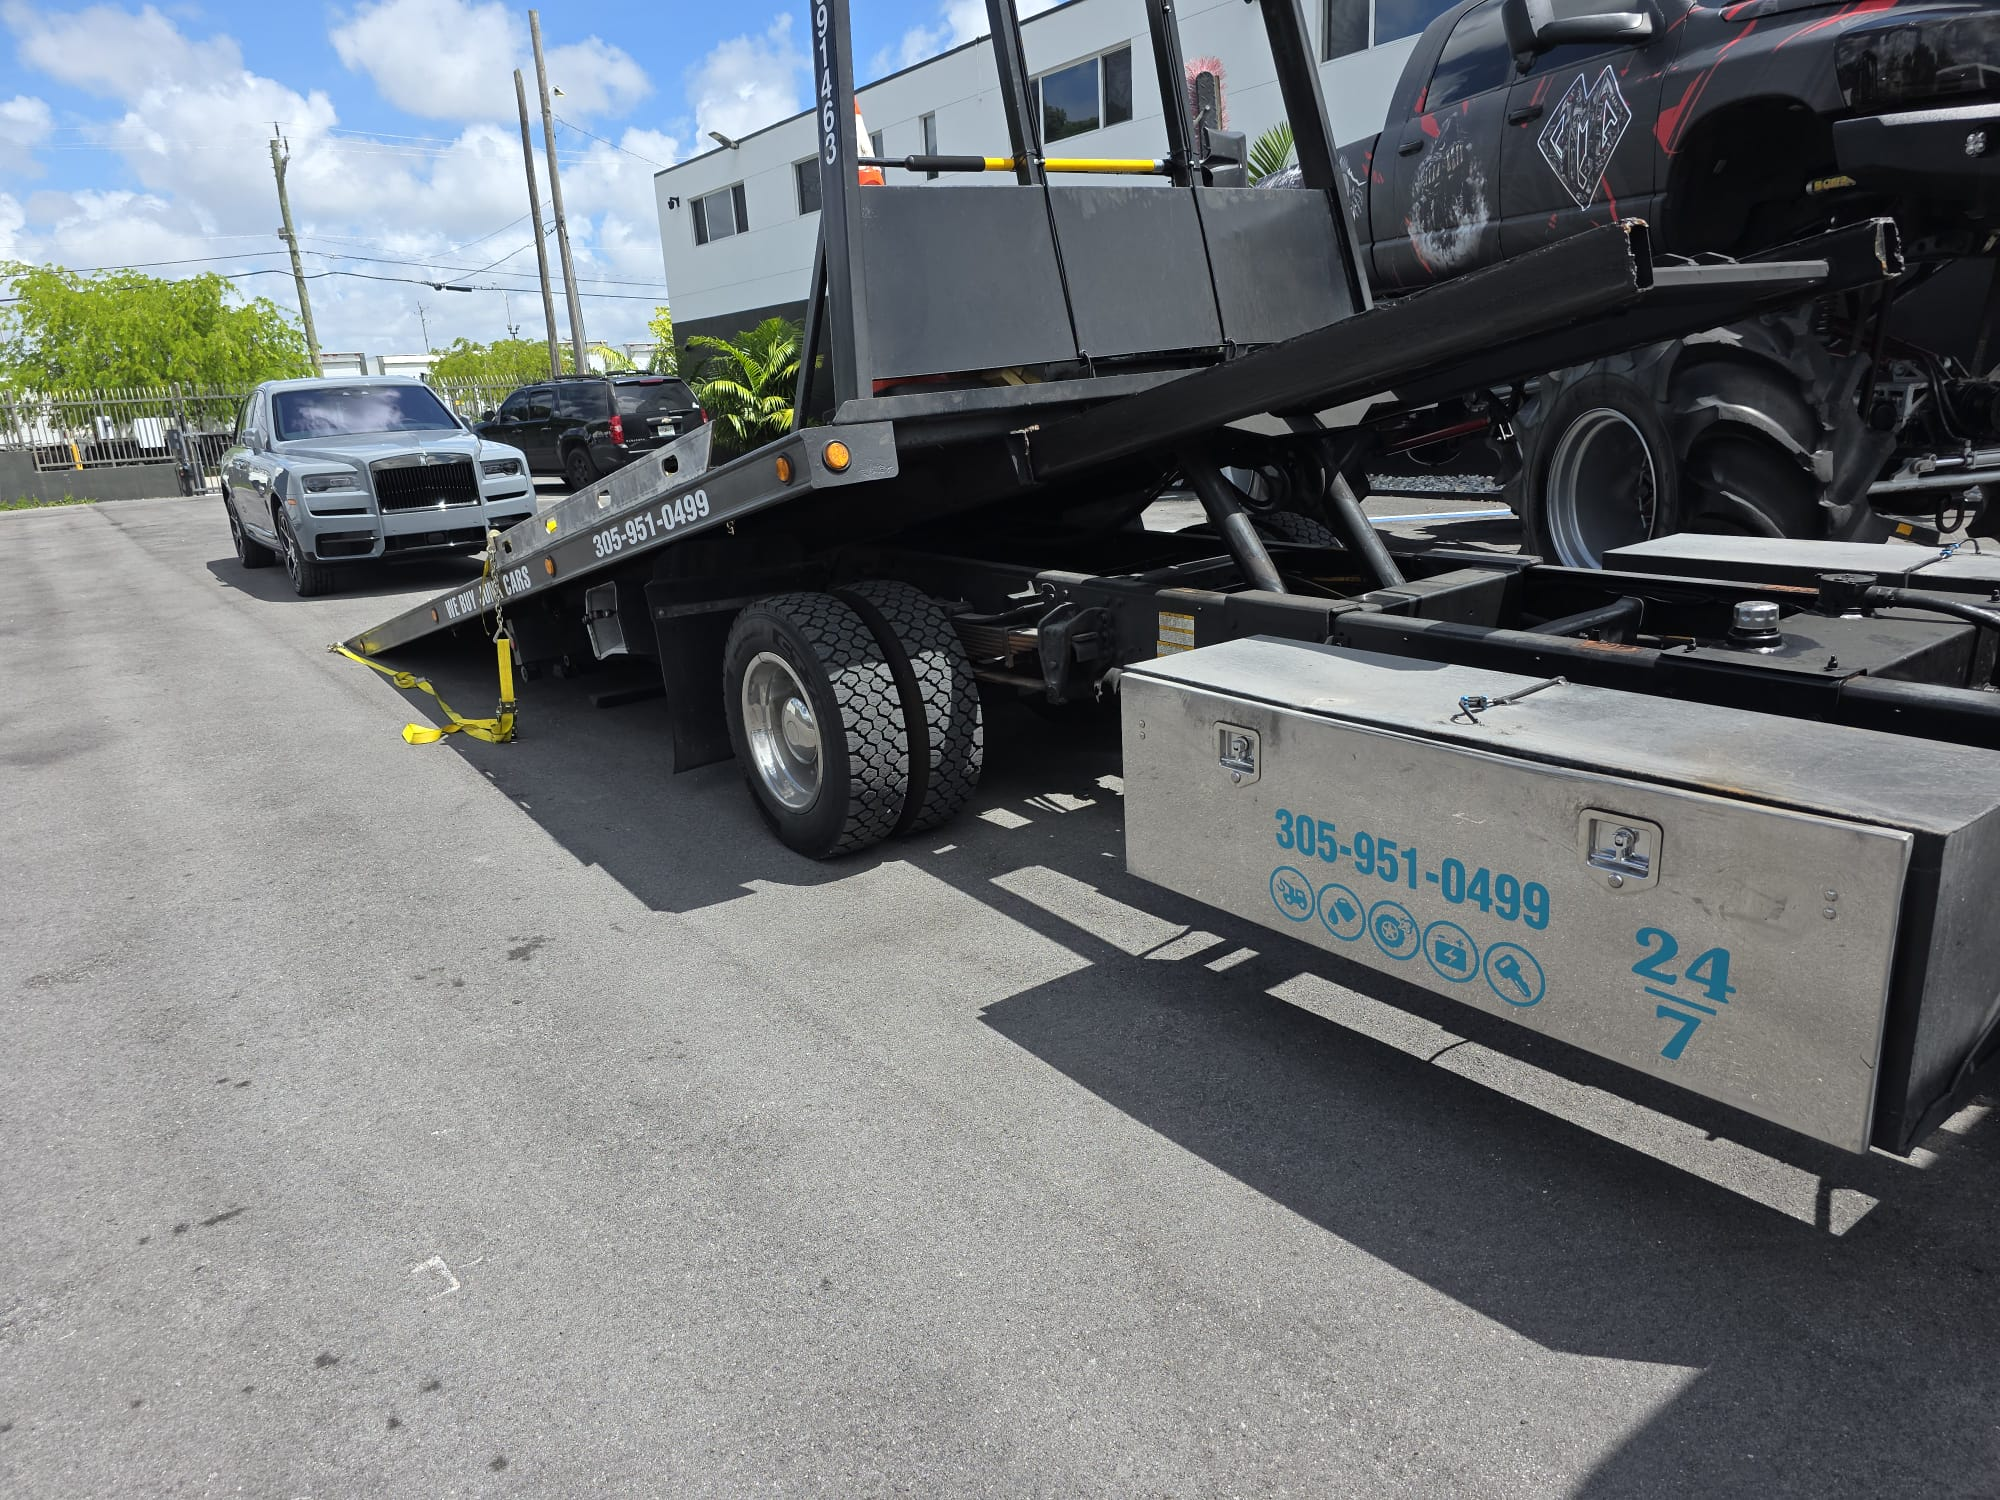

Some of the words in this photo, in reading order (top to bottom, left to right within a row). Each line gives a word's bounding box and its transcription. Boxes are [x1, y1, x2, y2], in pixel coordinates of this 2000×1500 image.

[815, 0, 837, 165] 91463
[593, 489, 710, 558] 305-951-0499
[444, 596, 461, 619] WE
[457, 589, 477, 615] BUY
[502, 565, 532, 596] CARS
[1275, 808, 1550, 930] 305-951-0499
[1631, 926, 1737, 1005] 24
[1656, 1004, 1702, 1061] 7
